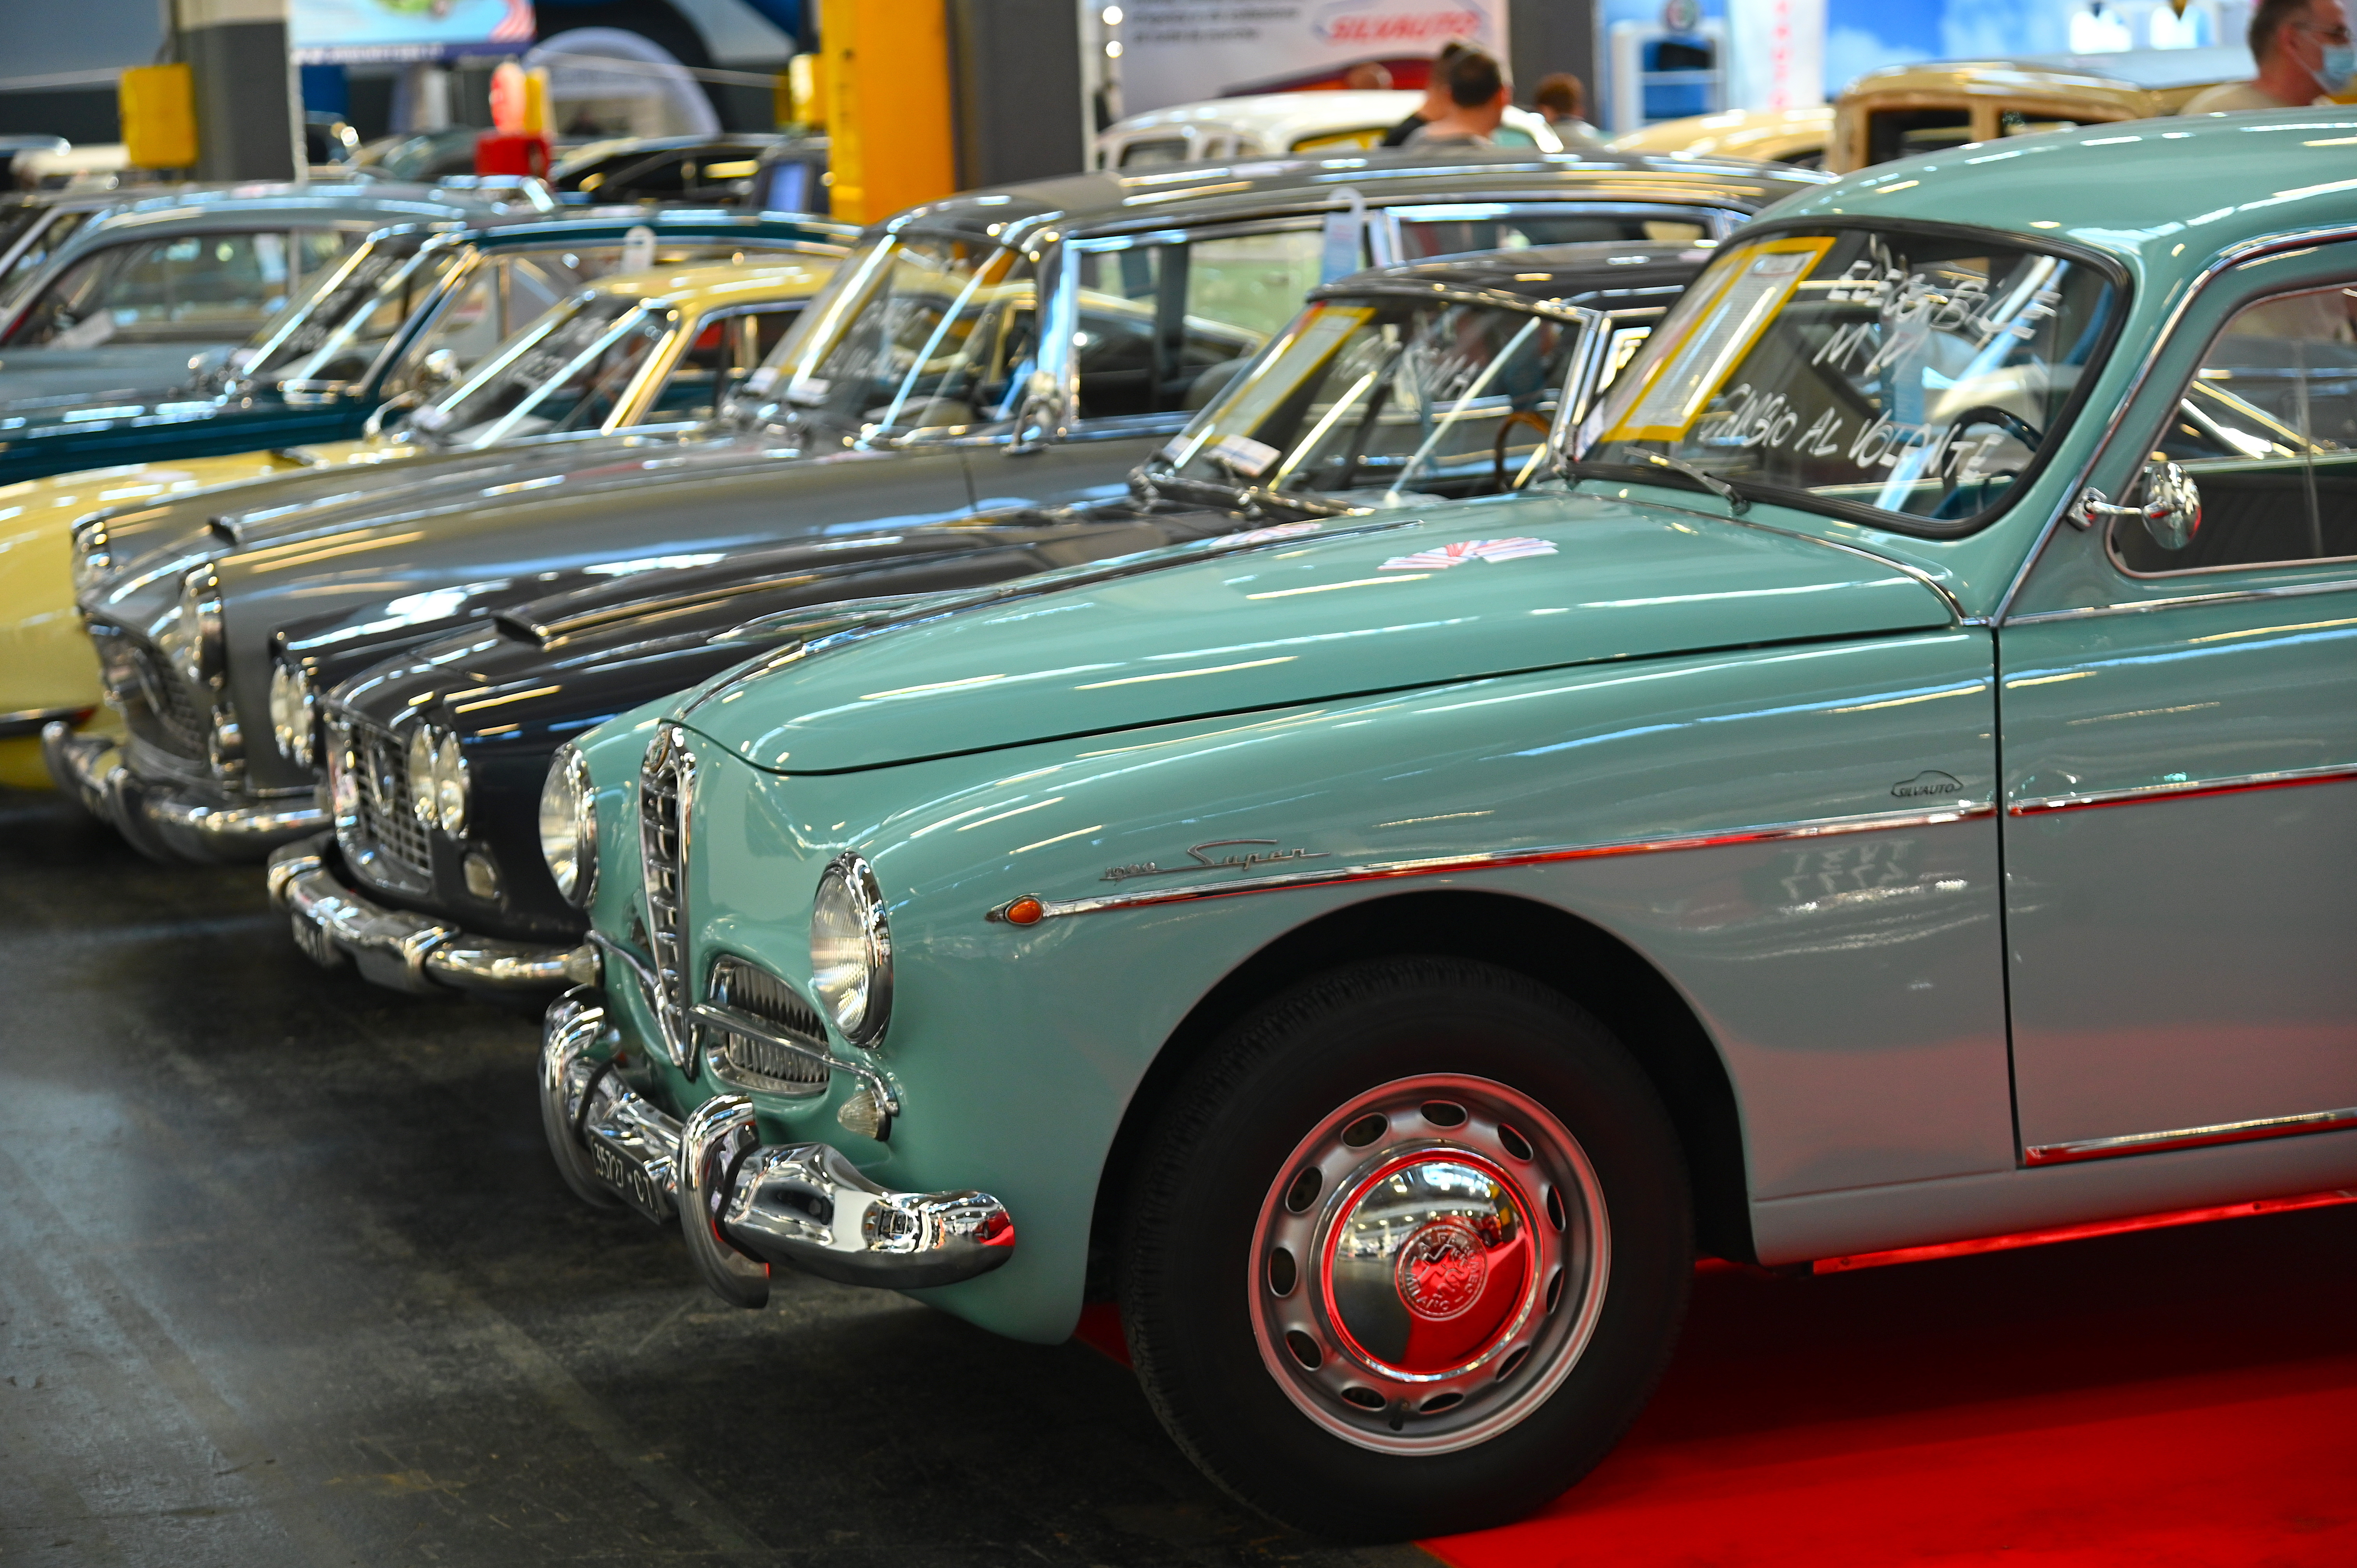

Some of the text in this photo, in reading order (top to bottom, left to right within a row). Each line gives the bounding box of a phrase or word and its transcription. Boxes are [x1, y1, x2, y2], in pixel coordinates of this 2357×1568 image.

[1794, 406, 1843, 457] AL
[1848, 409, 2005, 482] VOLANTE
[1100, 839, 1330, 884] 1900 Super
